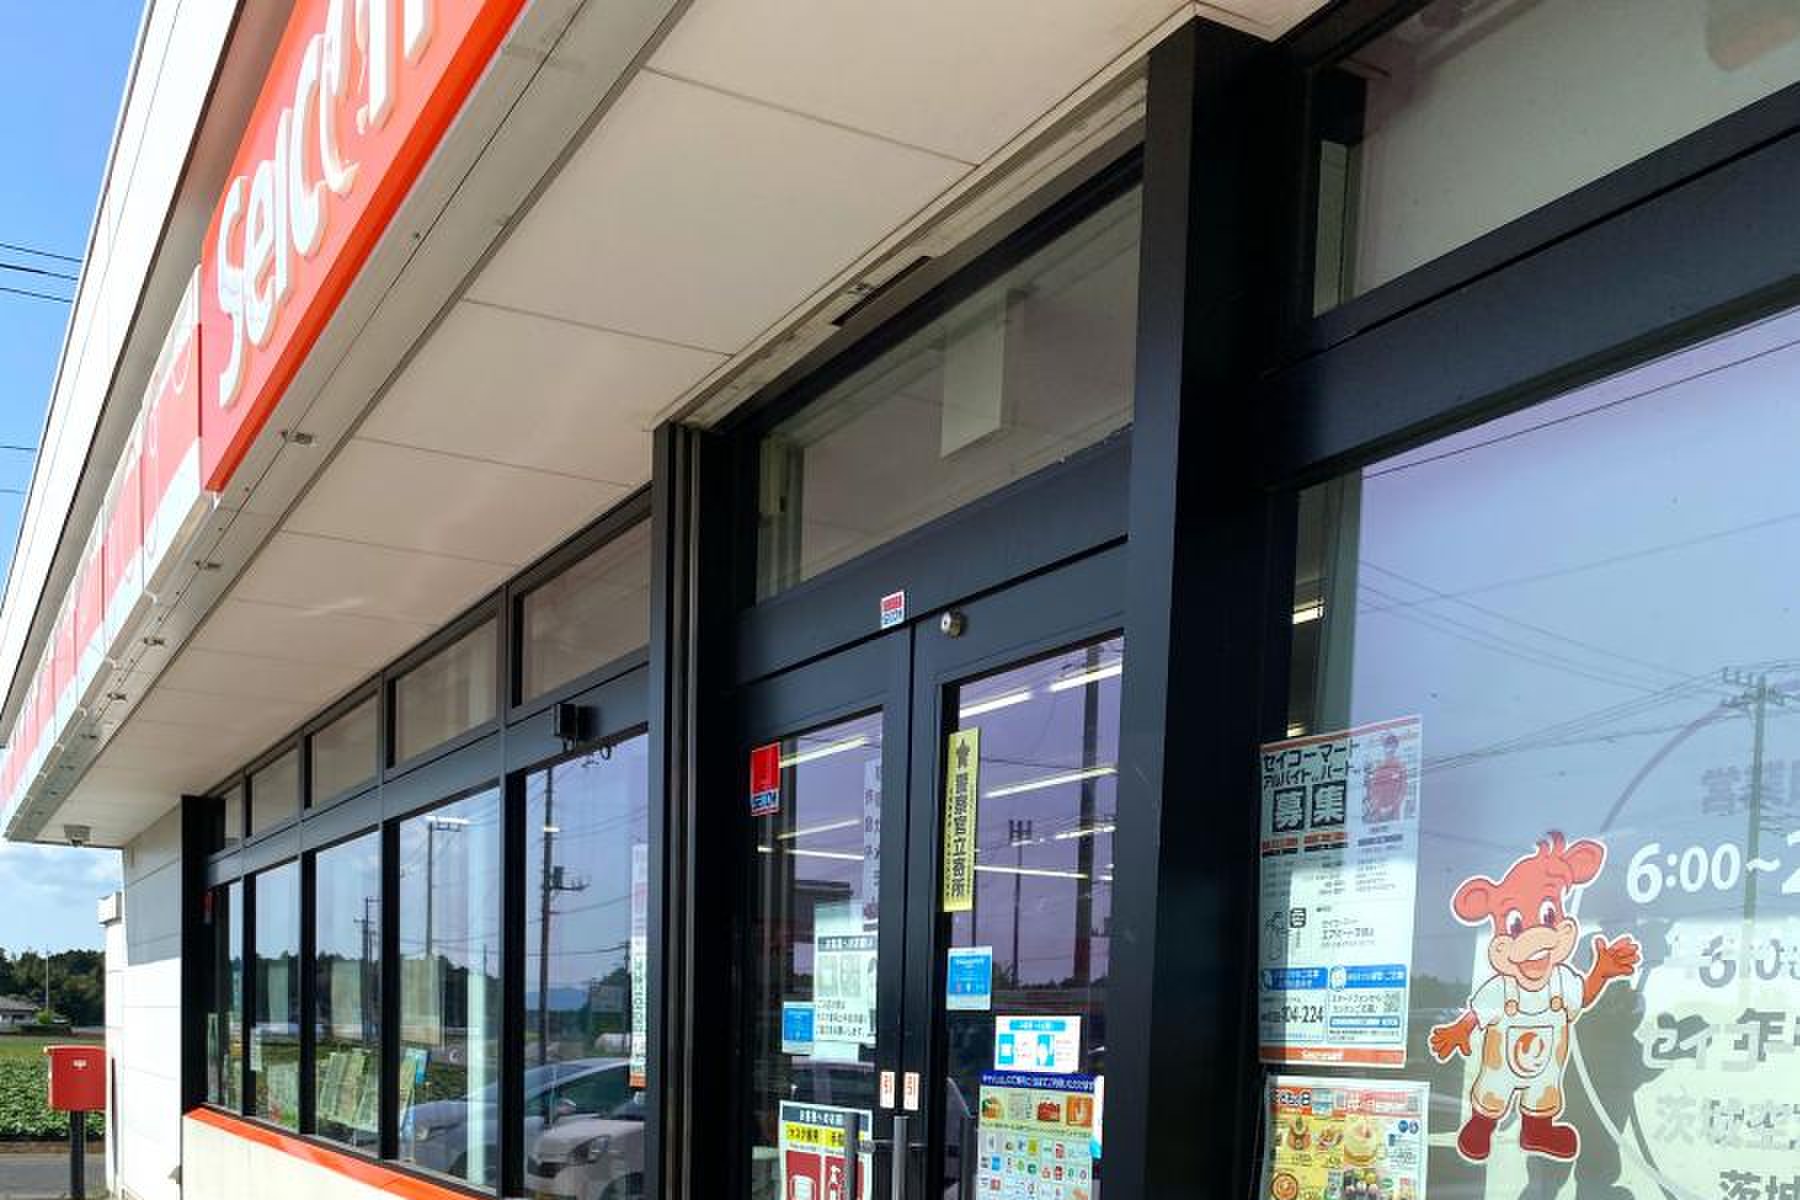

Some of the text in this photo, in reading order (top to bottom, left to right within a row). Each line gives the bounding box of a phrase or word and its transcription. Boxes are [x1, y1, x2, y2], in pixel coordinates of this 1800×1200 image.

[1264, 739, 1360, 772] セイコーマート
[1273, 780, 1346, 832] 募集
